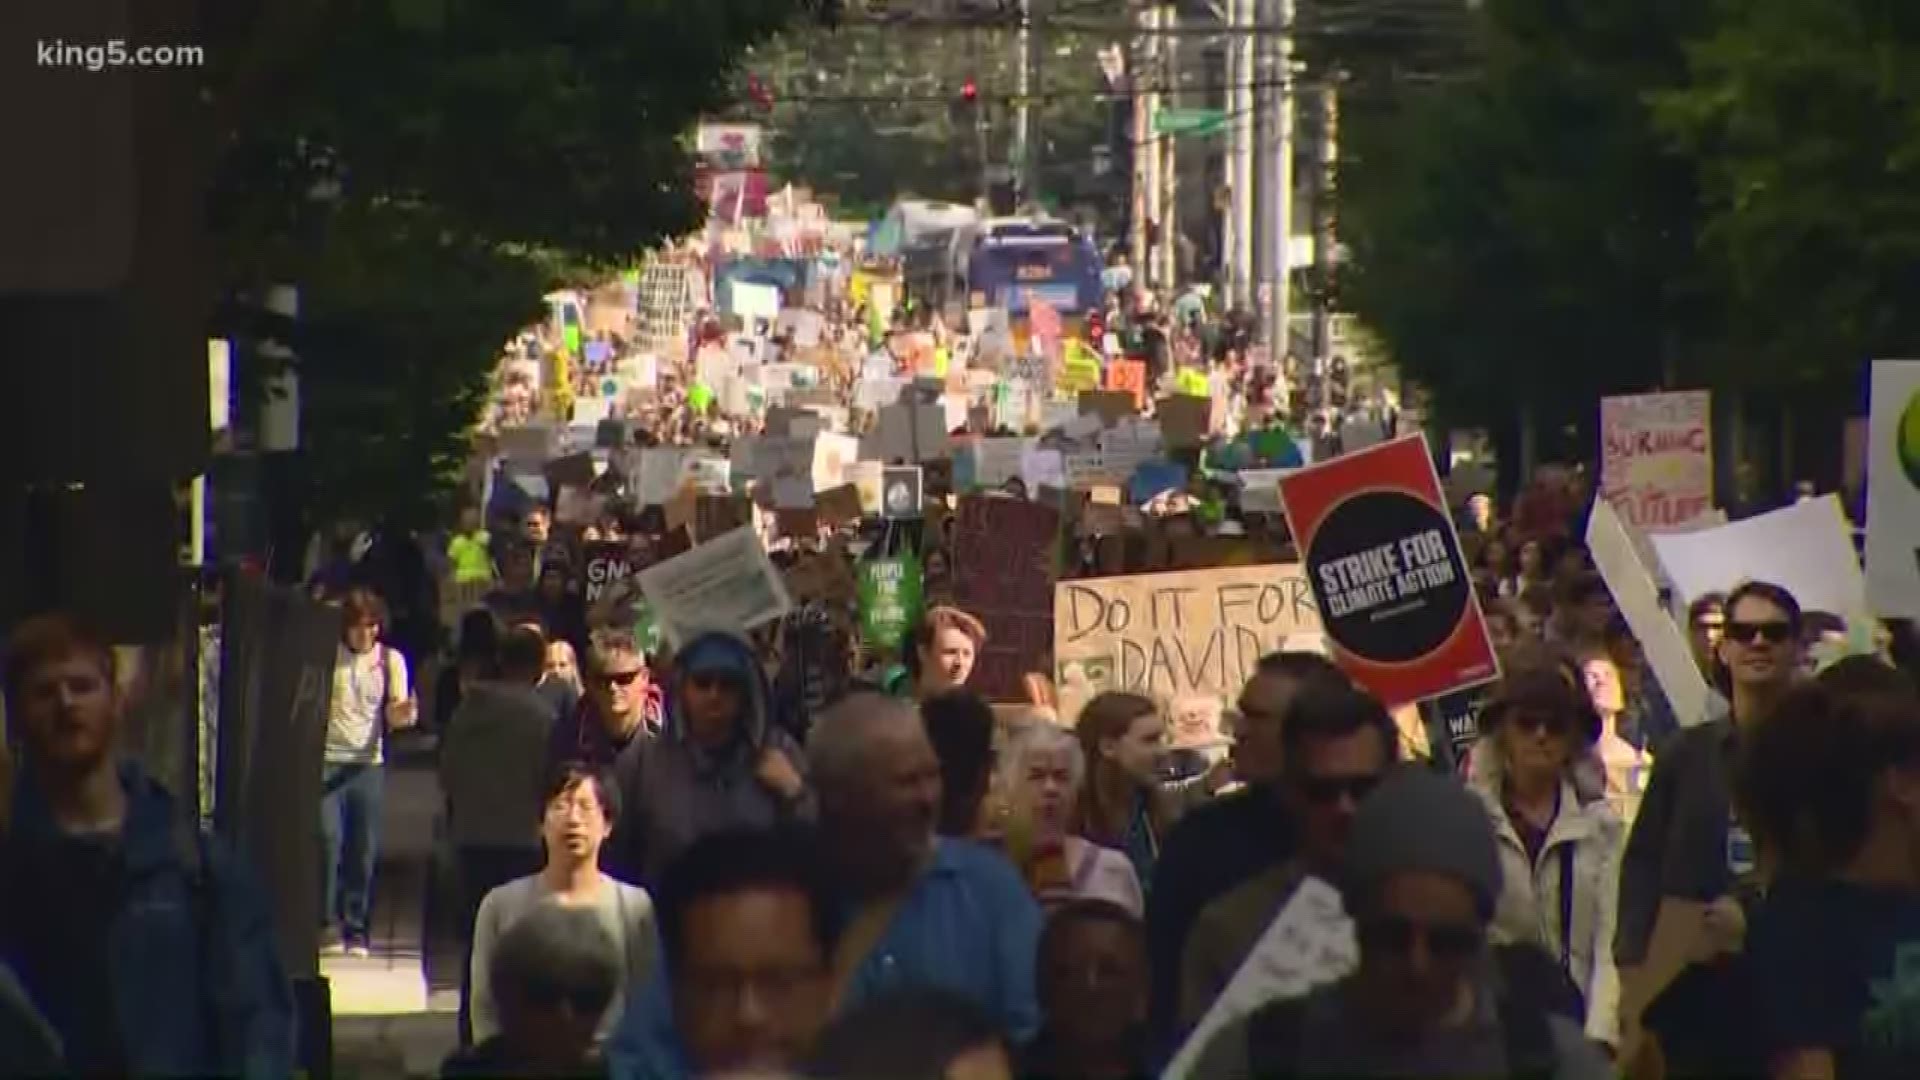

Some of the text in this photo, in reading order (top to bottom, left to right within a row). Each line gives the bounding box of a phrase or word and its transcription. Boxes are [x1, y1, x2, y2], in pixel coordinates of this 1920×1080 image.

[1319, 529, 1448, 594] STRIKE FOR
[1327, 579, 1396, 616] CLIMATE
[1395, 560, 1455, 597] ACTION
[1150, 587, 1201, 630] IT
[1217, 576, 1317, 626] FOR
[1121, 624, 1261, 692] DAVID
